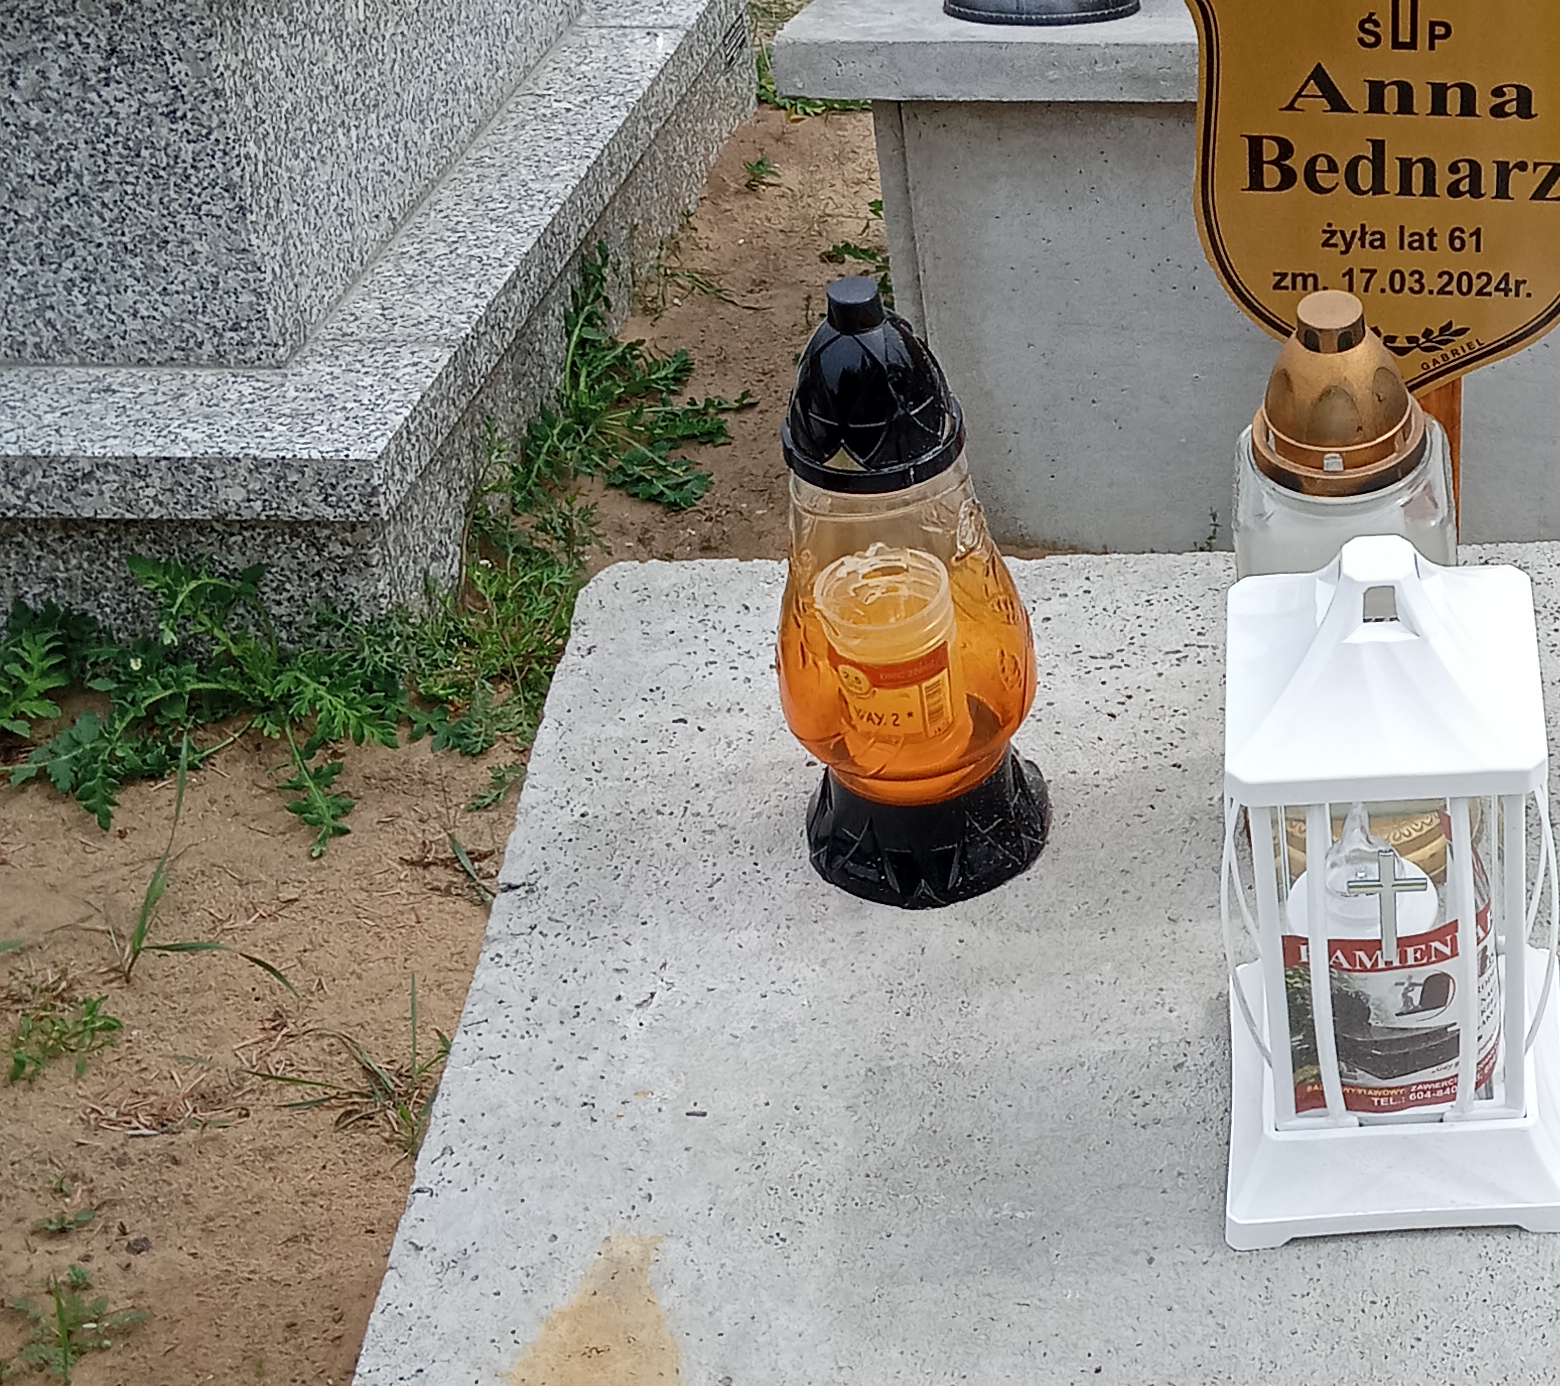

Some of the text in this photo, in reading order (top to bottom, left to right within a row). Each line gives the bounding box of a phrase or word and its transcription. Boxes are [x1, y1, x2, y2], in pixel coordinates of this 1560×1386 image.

[1356, 11, 1452, 51] Ś P
[1279, 62, 1538, 120] Anna
[1321, 222, 1484, 255] żyła lat 61
[1272, 267, 1533, 299] zm. 17.03.2024r.
[1421, 338, 1486, 371] GABRIEL
